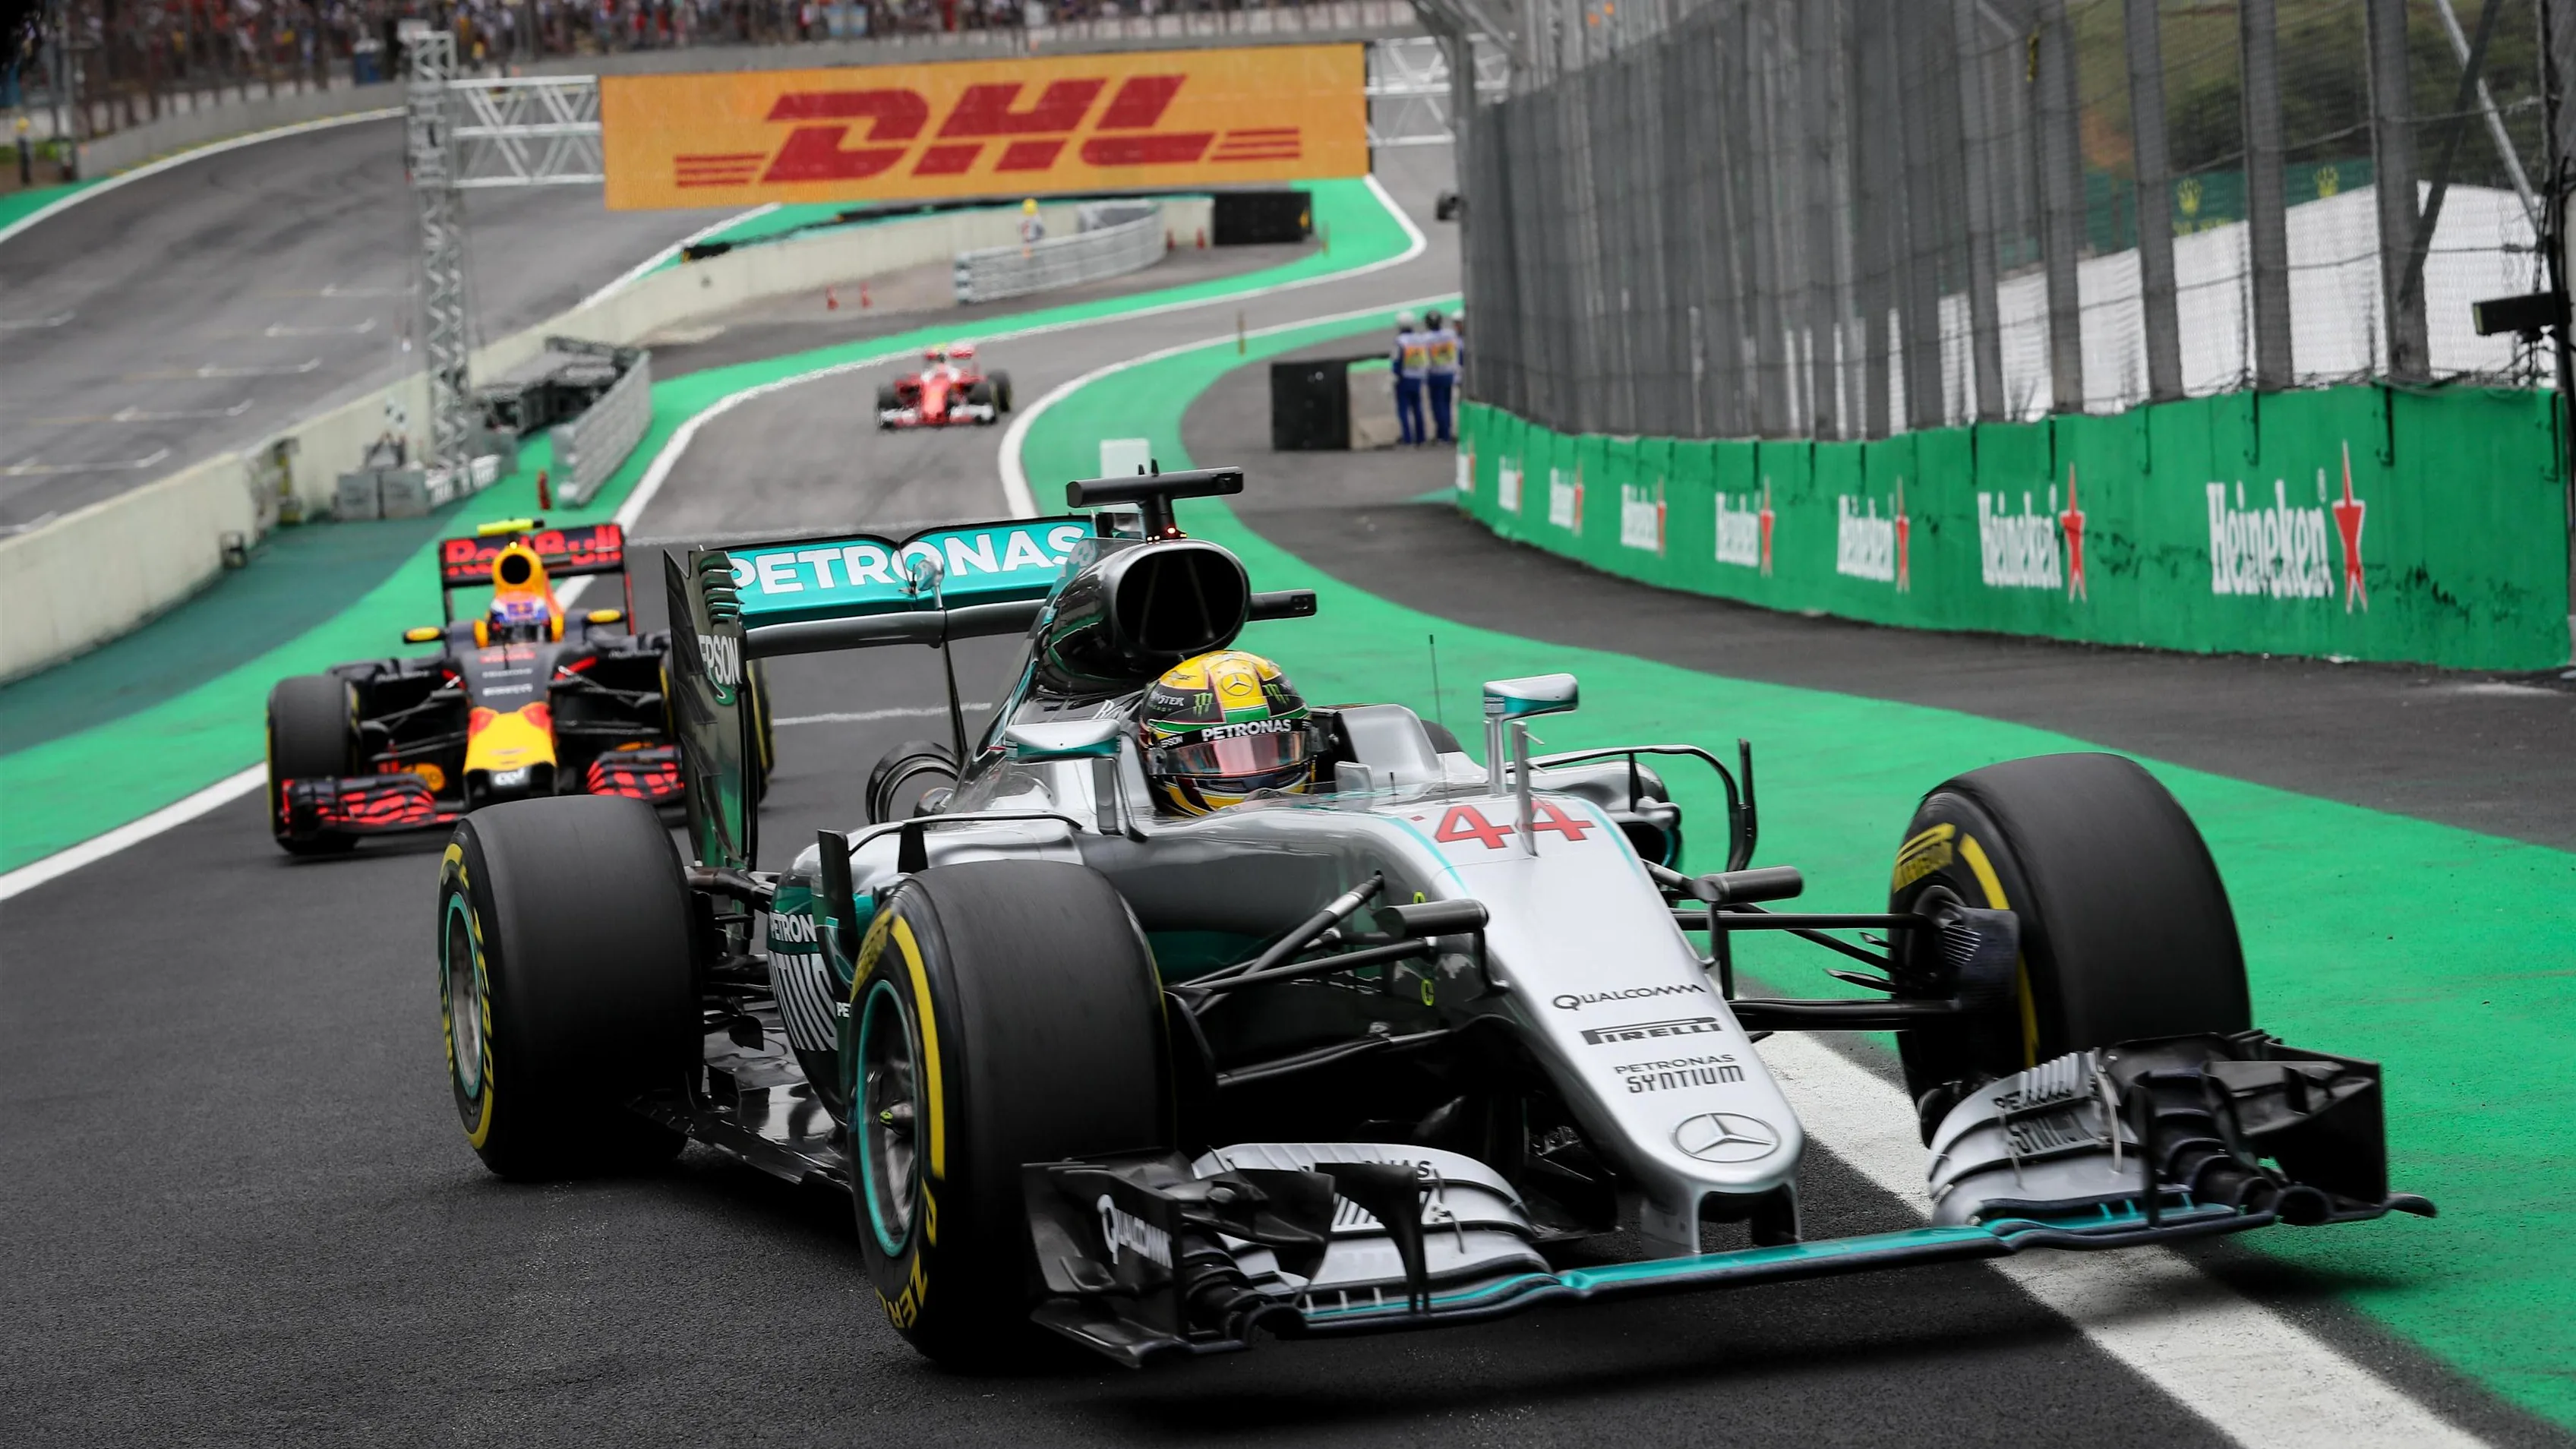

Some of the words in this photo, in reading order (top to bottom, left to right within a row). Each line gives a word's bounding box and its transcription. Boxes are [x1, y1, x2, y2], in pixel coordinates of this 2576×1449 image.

[761, 74, 1216, 185] DHL
[2206, 478, 2334, 598] Heineken
[730, 526, 1084, 595] PETRONAS
[699, 635, 742, 685] EPSON
[1201, 719, 1292, 741] PETRONAS
[1435, 800, 1596, 849] 44
[1552, 984, 1707, 1011] QUALCOMM
[1579, 1016, 1723, 1046] PIRELLI
[1613, 1053, 1737, 1075] PETRONAS
[1626, 1065, 1746, 1094] SYNTIUM
